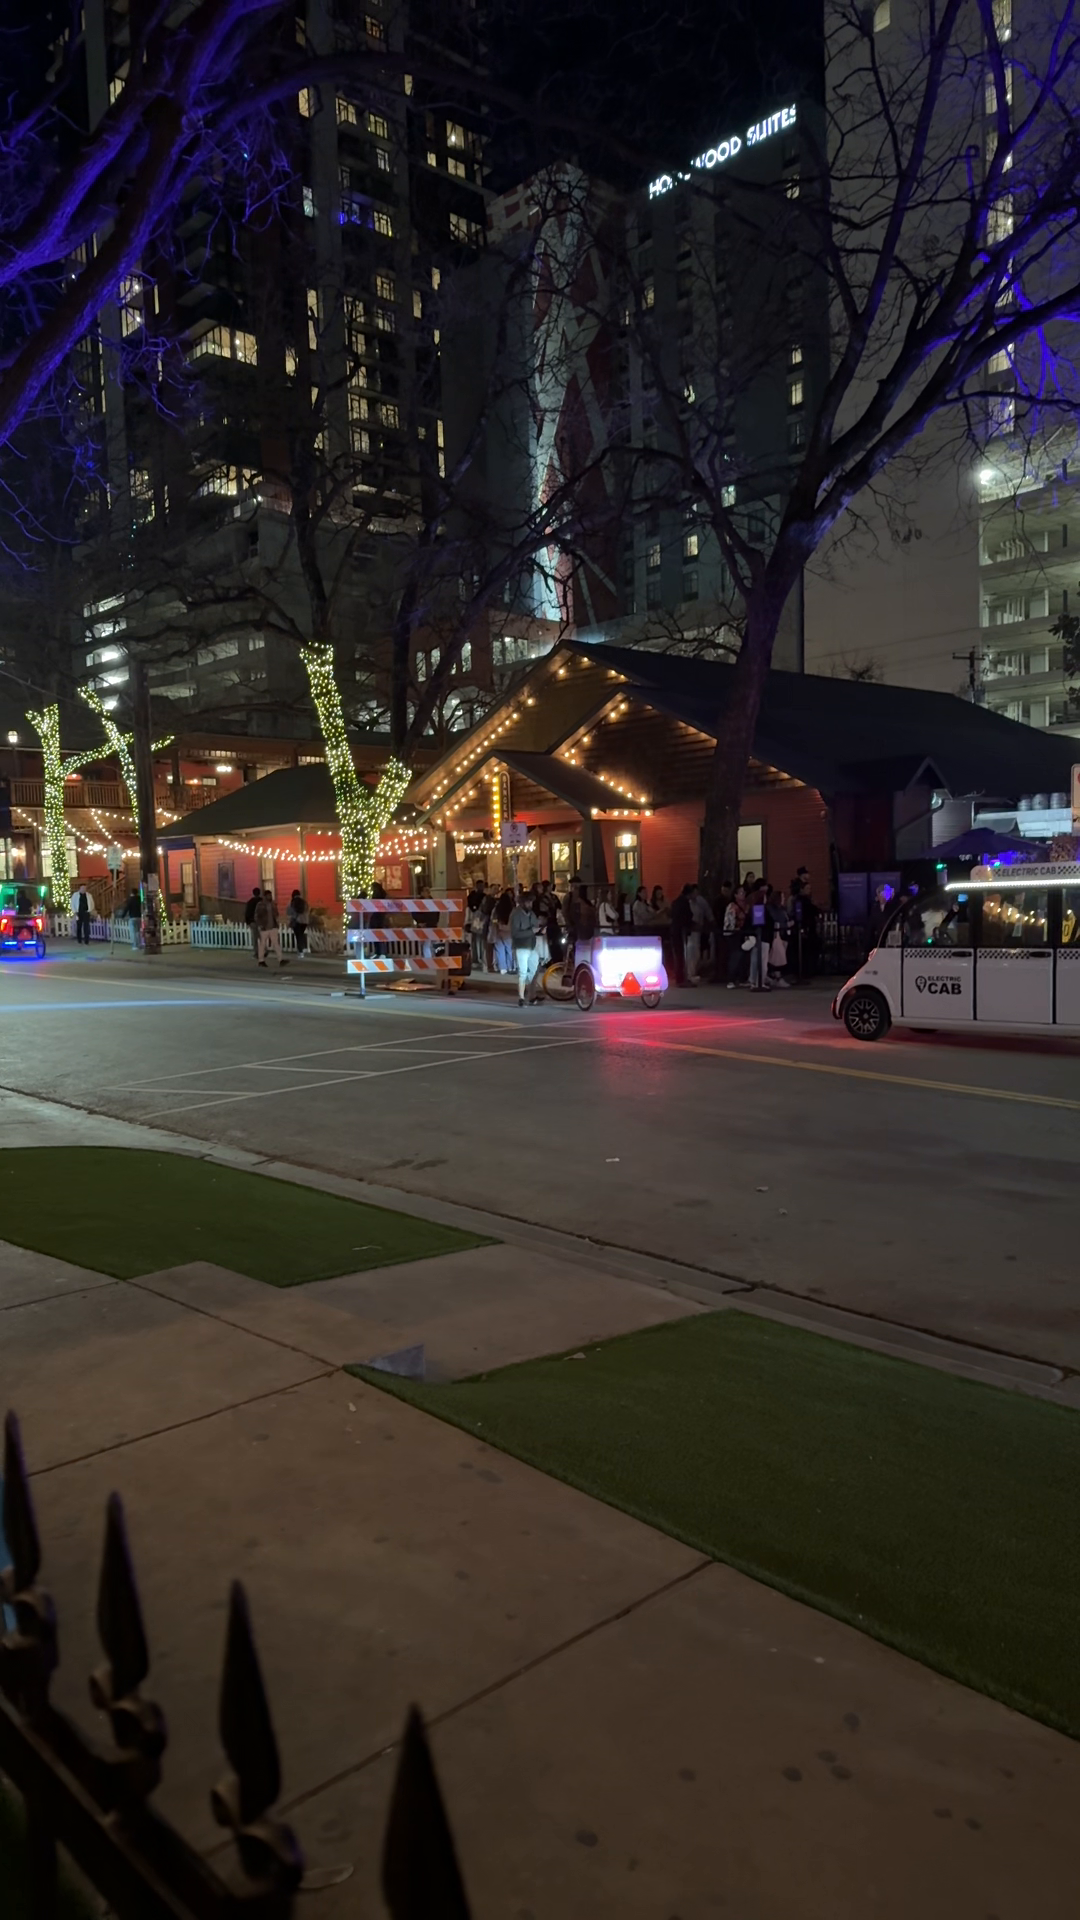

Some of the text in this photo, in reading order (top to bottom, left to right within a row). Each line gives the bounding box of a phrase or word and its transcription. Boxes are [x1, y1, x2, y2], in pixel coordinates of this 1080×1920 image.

[746, 103, 797, 146] SUITES
[1001, 865, 1057, 877] ELECTRIC CAB
[927, 982, 962, 995] CAB
